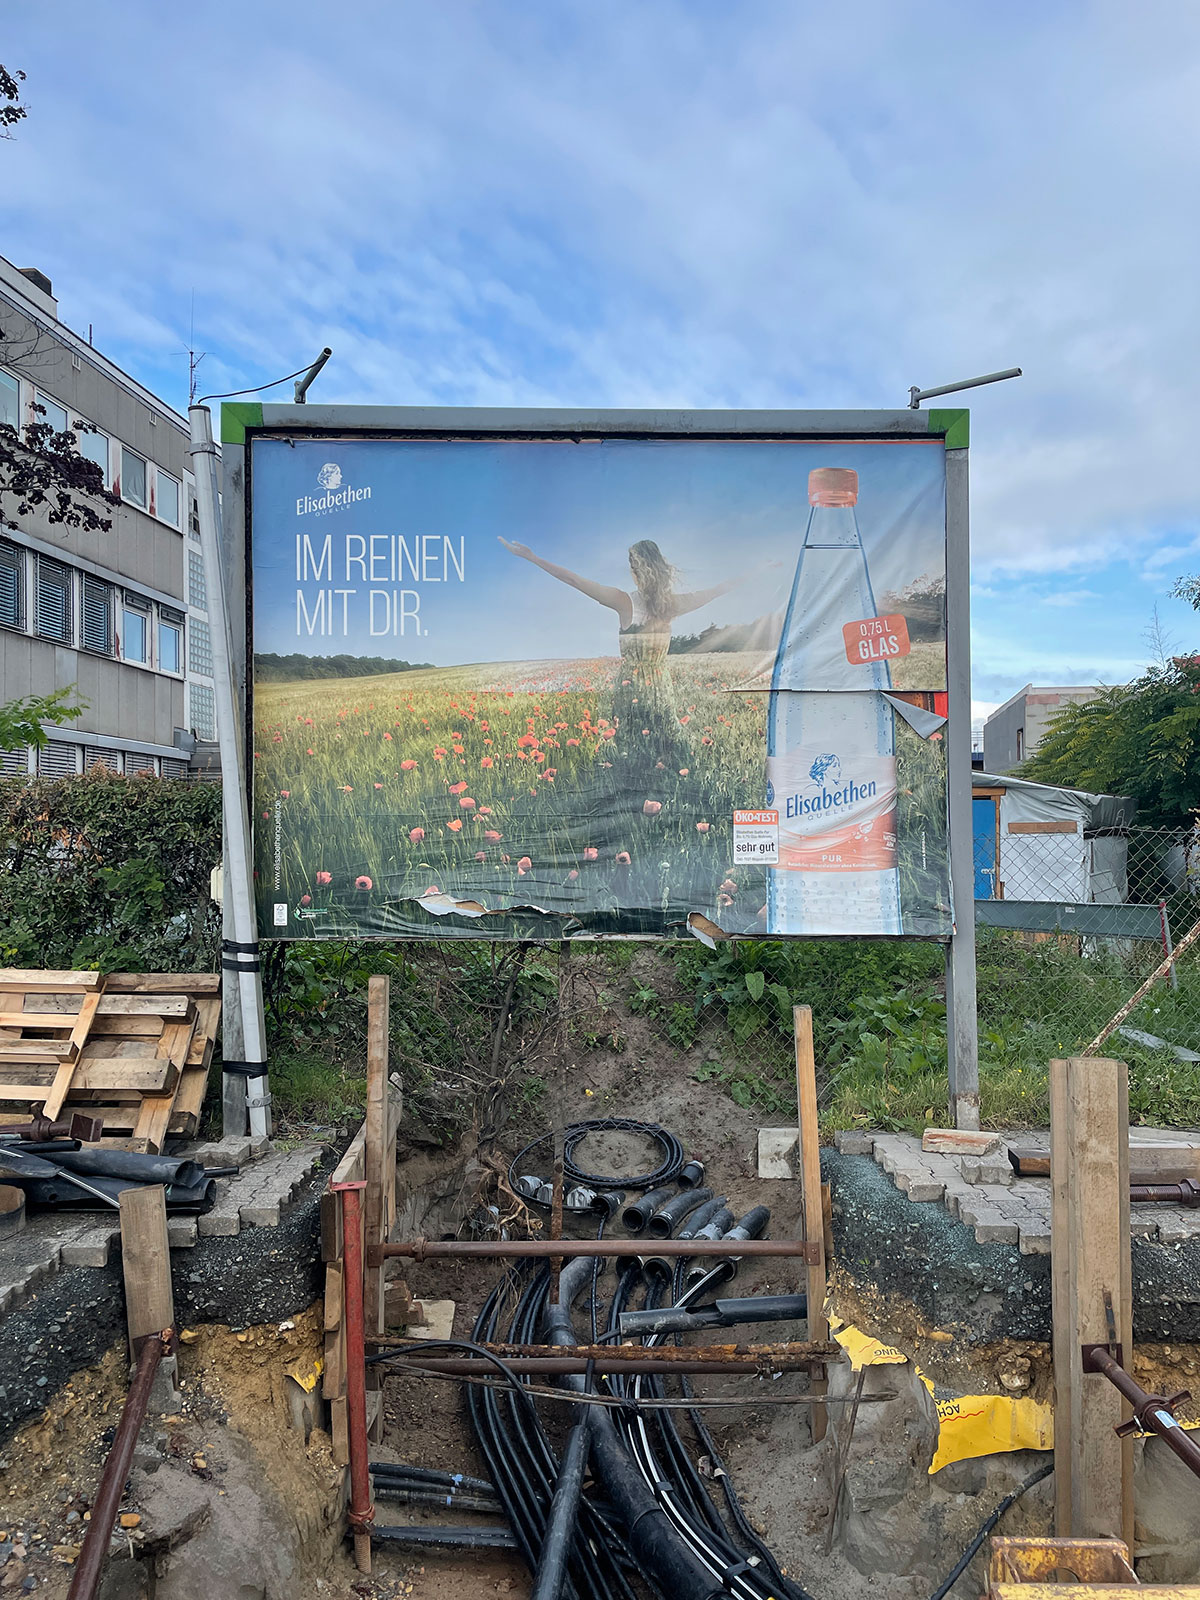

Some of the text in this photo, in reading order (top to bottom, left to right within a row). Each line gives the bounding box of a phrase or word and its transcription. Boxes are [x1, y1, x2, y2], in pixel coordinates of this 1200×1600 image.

[296, 485, 371, 516] Elisabethen
[315, 504, 351, 517] QUELLE
[296, 534, 465, 582] IM REINEN
[296, 589, 429, 637] MIT DIR.
[884, 620, 892, 632] L
[858, 635, 900, 660] GLAS
[786, 780, 876, 819] Elisabethen
[807, 804, 854, 820] QUELLE
[736, 841, 775, 854] sehr gut
[821, 854, 843, 862] PUR
